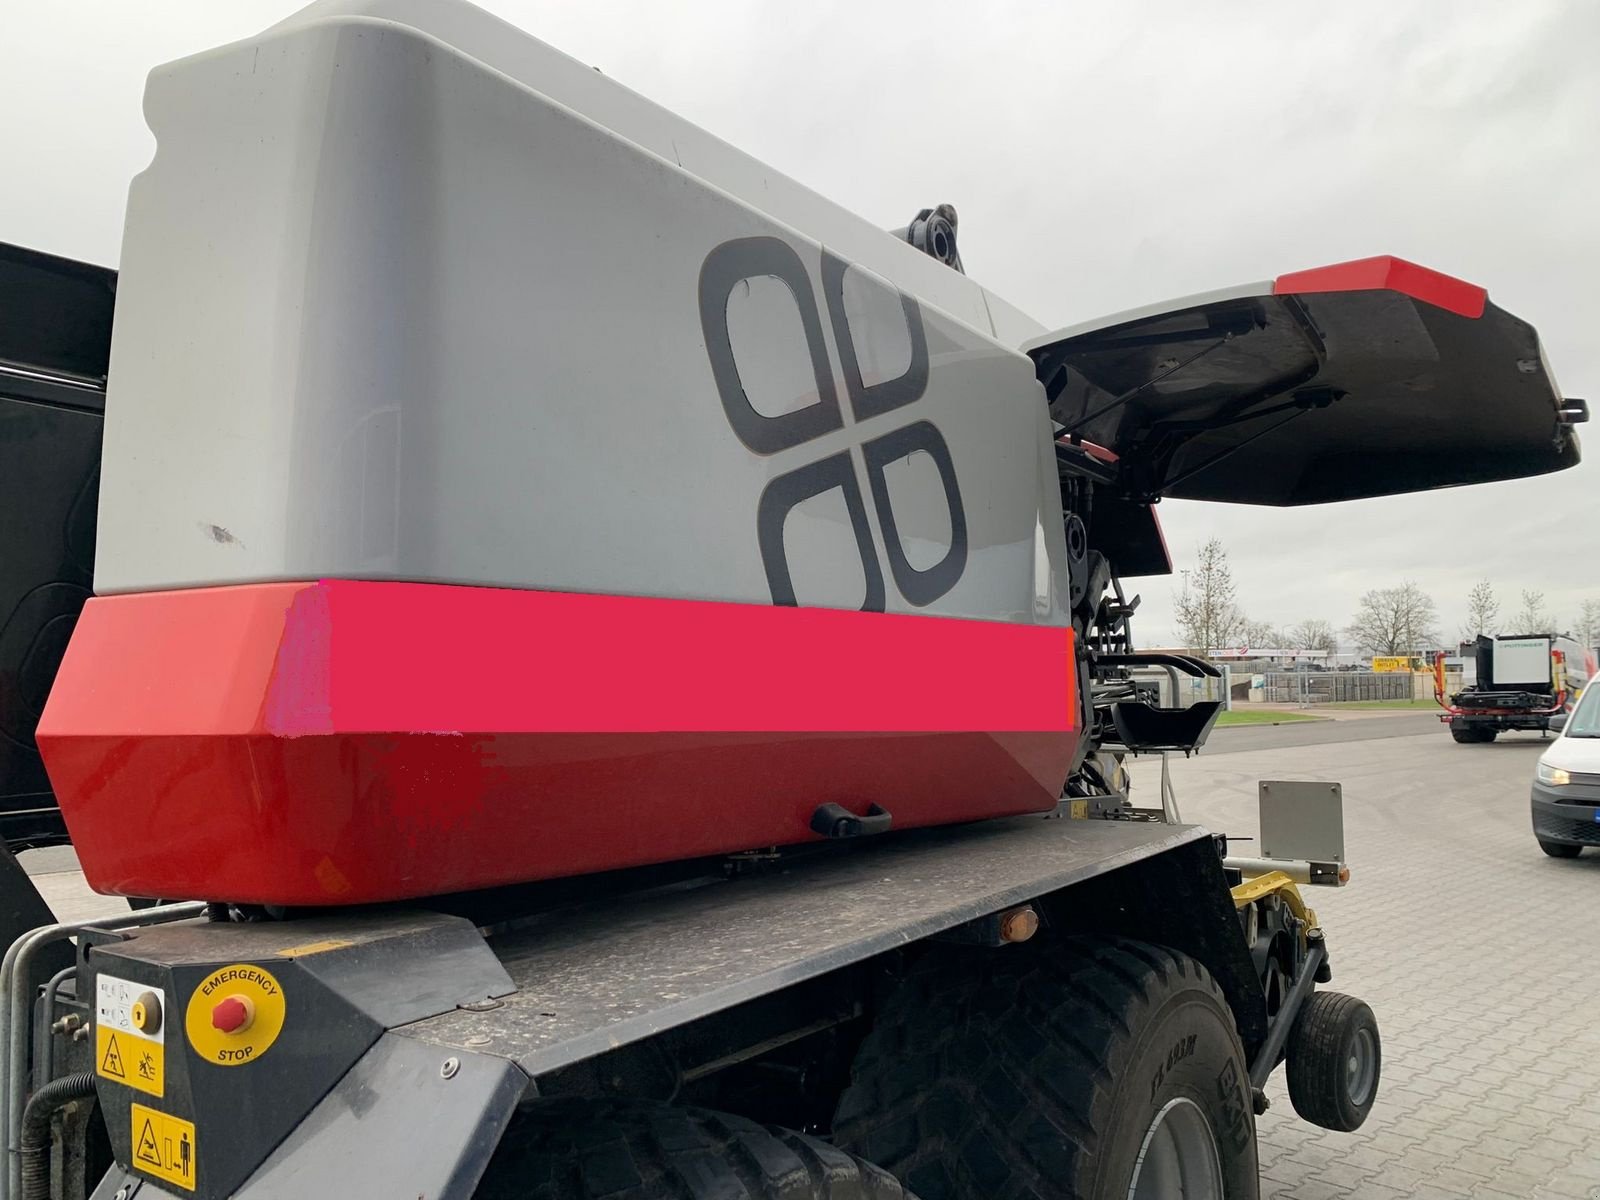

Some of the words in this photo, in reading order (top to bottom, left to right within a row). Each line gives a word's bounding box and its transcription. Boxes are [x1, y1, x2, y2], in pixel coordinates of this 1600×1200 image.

[202, 970, 277, 996] EMERGENCY
[218, 1046, 253, 1061] STOP
[1217, 1056, 1251, 1154] BKT
